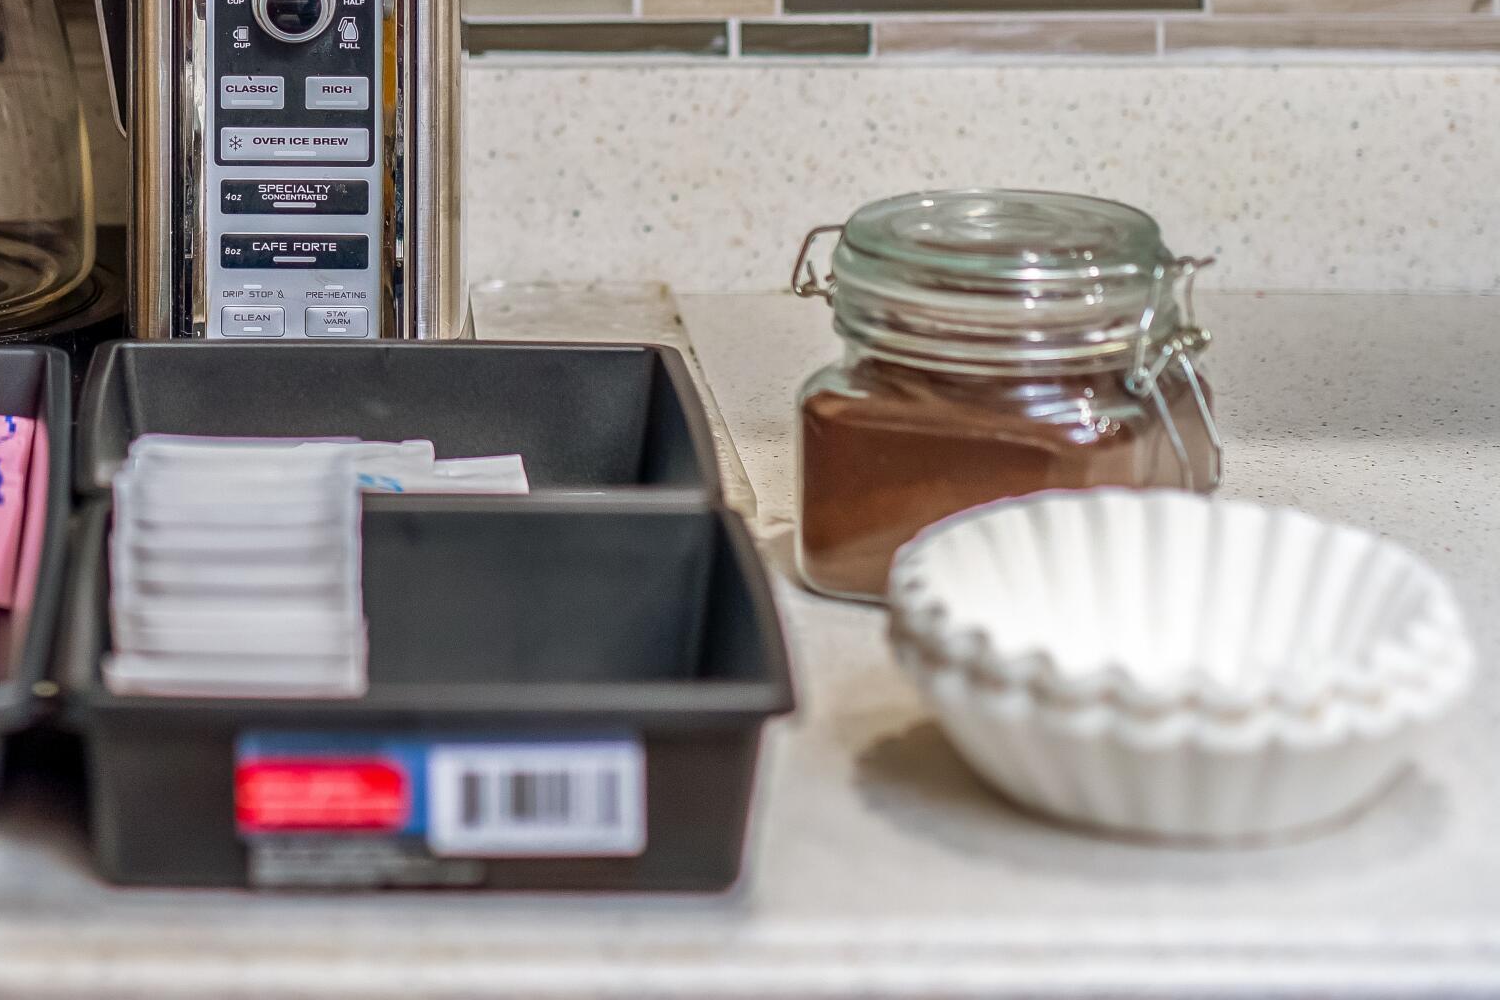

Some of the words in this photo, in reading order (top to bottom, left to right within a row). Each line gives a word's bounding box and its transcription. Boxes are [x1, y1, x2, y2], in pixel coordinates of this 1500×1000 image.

[225, 84, 278, 93] CLASSIC
[322, 85, 352, 94] RICH
[252, 137, 286, 145] OVER
[289, 137, 310, 145] ICE
[313, 137, 349, 146] BREW
[258, 184, 331, 193] SPECIALTY
[225, 193, 242, 201] 4oz
[261, 193, 328, 201] CONCENTRATED
[224, 247, 241, 256] 8oz
[252, 242, 287, 251] CAFE
[293, 242, 337, 252] FORTE
[222, 290, 244, 298] DRIP
[249, 290, 274, 299] STOP
[305, 291, 367, 299] PRE-HEATING
